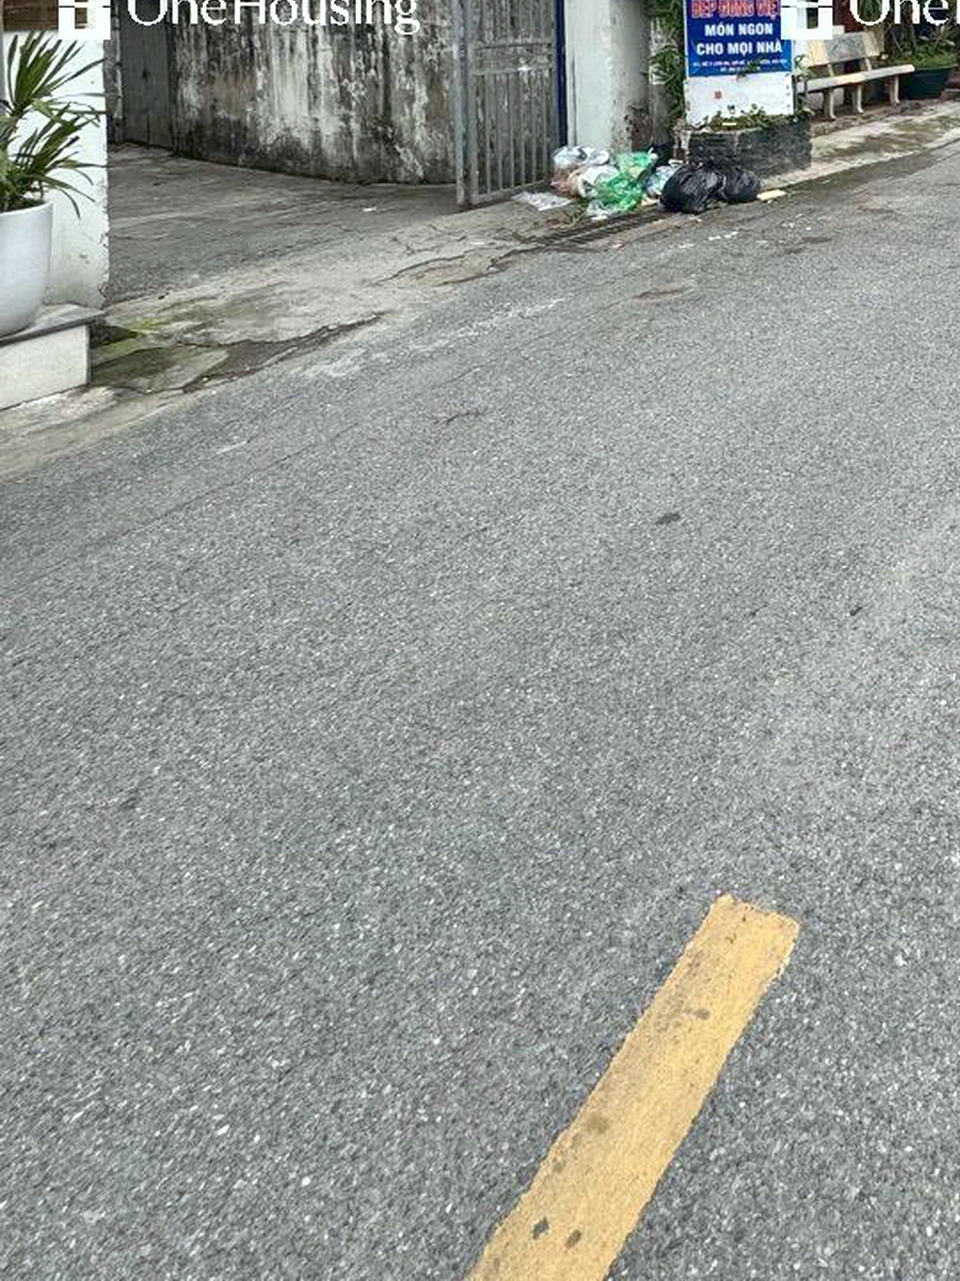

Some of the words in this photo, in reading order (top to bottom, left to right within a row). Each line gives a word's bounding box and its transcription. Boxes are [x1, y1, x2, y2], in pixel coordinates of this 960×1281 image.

[704, 21, 735, 37] MÓN
[738, 22, 774, 36] NGON
[696, 41, 725, 56] CHO
[727, 40, 754, 58] MỌI
[756, 38, 783, 54] NHÀ
